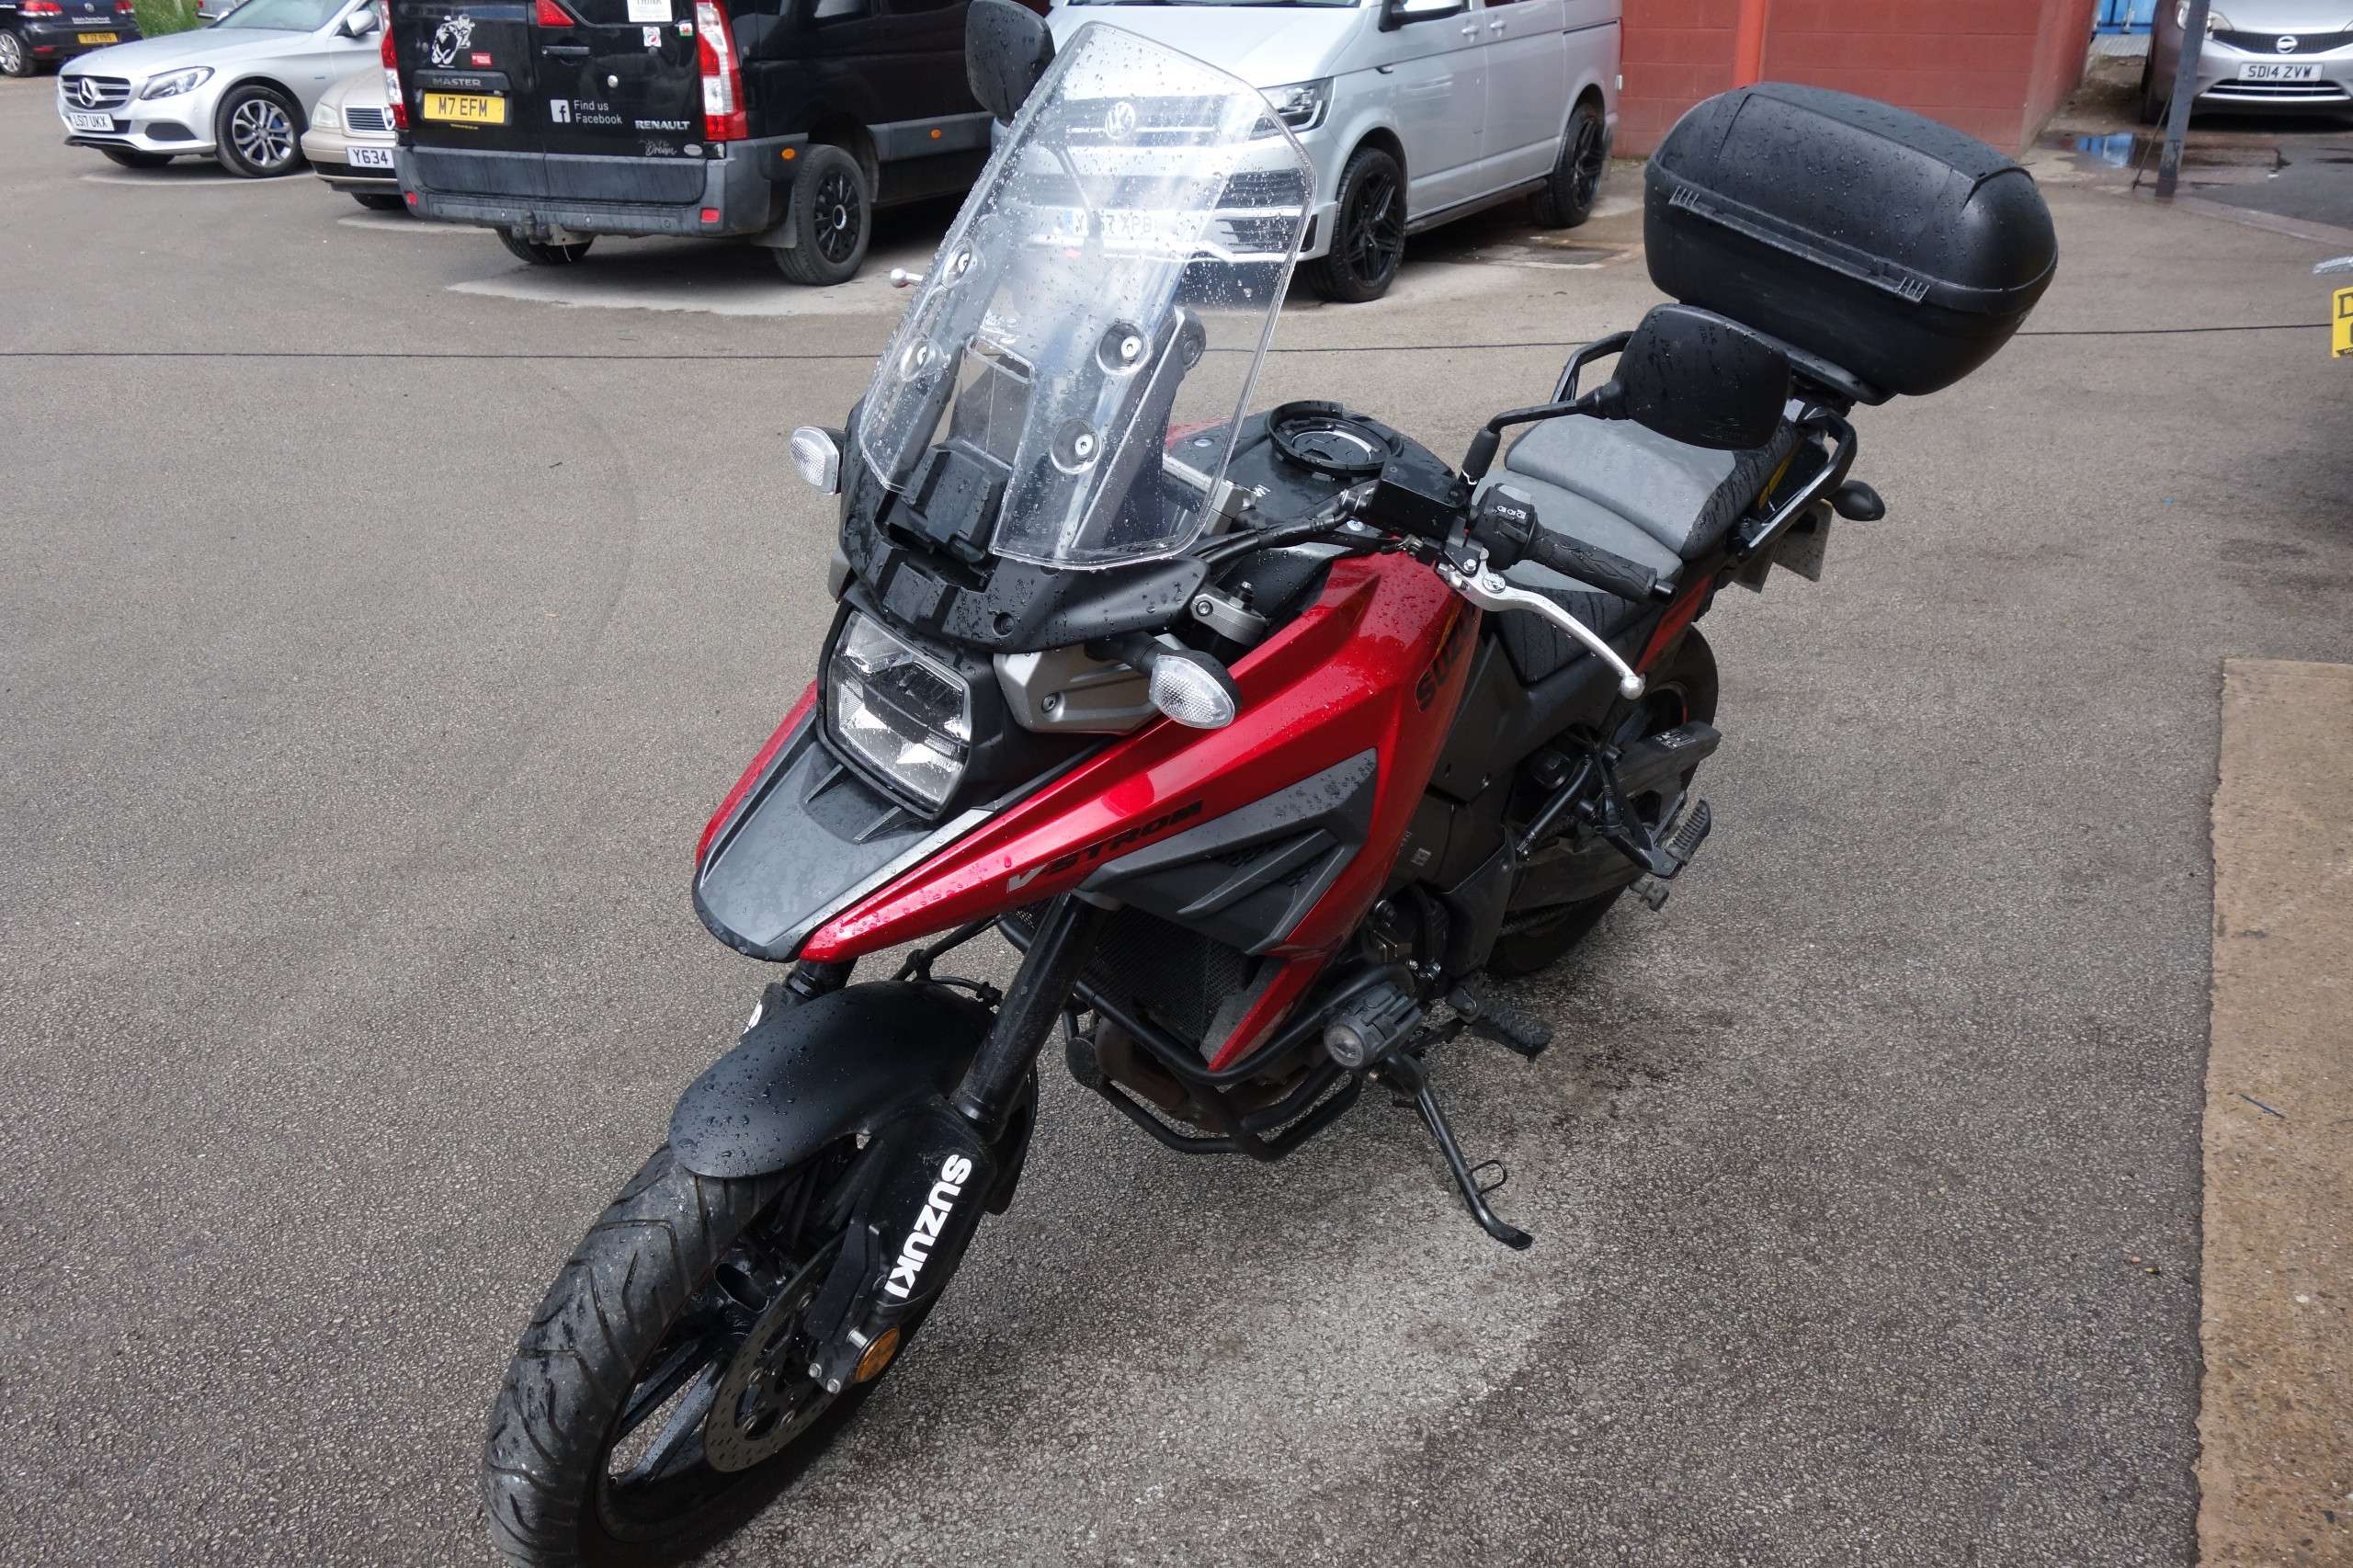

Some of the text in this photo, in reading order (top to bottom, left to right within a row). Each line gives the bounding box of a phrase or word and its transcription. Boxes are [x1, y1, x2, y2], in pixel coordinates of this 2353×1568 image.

[432, 77, 482, 87] MASTER
[438, 96, 488, 118] M7 EFM
[574, 99, 609, 111] Find us
[575, 113, 623, 125] Facebook
[634, 119, 690, 131] RENAULT
[352, 149, 389, 165] Y634
[884, 1154, 972, 1299] SUZUKI
